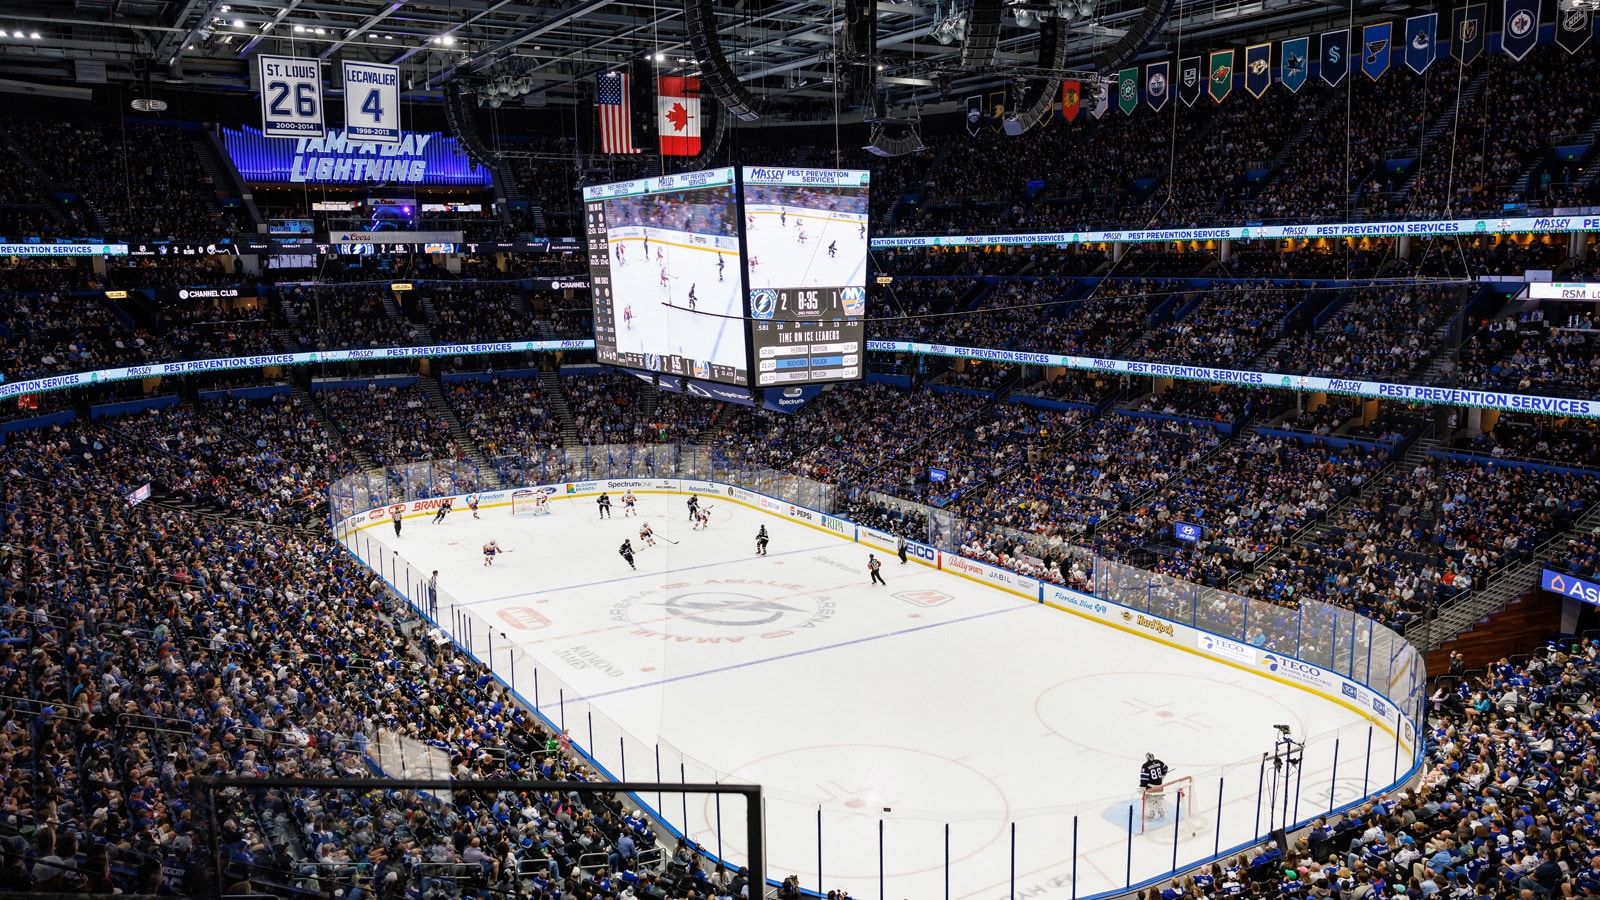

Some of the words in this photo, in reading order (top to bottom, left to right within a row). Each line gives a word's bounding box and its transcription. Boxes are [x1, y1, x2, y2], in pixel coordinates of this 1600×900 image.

[267, 64, 282, 76] ST.
[286, 66, 315, 78] LOUIS
[347, 70, 396, 86] LECAVALIER
[268, 80, 317, 118] 26
[360, 88, 384, 123] 4
[290, 156, 426, 182] LIGHTNING
[751, 168, 784, 180] MASSEY
[658, 176, 674, 186] MASSEY
[1282, 226, 1308, 235] MASSEY
[1317, 226, 1339, 234] PEST
[1341, 224, 1405, 234] PREVENTION
[1407, 223, 1459, 232] SERVICES
[1533, 218, 1570, 228] MASSEY
[1145, 230, 1191, 239] PREVENTION
[781, 293, 787, 310] 2
[798, 291, 818, 310] 8:35
[832, 292, 837, 308] 1
[779, 333, 792, 343] TIME
[795, 332, 802, 342] ON
[804, 332, 813, 341] ICE
[816, 330, 839, 340] LEADERS
[405, 346, 469, 356] PREVENTION
[471, 343, 512, 352] SERVICES
[930, 345, 947, 353] MASSEY
[954, 348, 970, 356] PEST
[971, 349, 1013, 360] PREVENTION
[1015, 353, 1049, 363] SERVICES
[127, 366, 152, 376] MASSEY
[164, 362, 185, 372] PEST
[187, 357, 248, 370] PREVENTION
[249, 354, 294, 365] SERVICES
[664, 357, 668, 371] 2
[687, 360, 690, 375] 1
[1093, 359, 1115, 368] MASSEY
[1127, 362, 1148, 372] PEST
[1150, 364, 1210, 378] PREVENTION
[1213, 370, 1262, 383] SERVICES
[42, 375, 80, 388] SERVICES
[1328, 379, 1362, 391] MASSEY
[1379, 384, 1412, 397] PEST
[1415, 387, 1508, 406] PREVENTION
[1511, 396, 1590, 414] SERVICES
[796, 509, 812, 520] PEPSI
[827, 517, 844, 533] RIPA
[906, 542, 934, 560] EICO
[949, 556, 968, 572] Bally
[968, 565, 983, 575] SPORTS
[988, 571, 1011, 584] JABIL
[1055, 592, 1078, 605] Florida
[1079, 599, 1093, 609] Blue
[1137, 615, 1155, 629] Hard
[1155, 620, 1174, 637] Rock
[1214, 639, 1244, 652] TECO
[1280, 658, 1320, 676] TECO
[1282, 667, 1300, 676] TAMPA
[1303, 674, 1332, 686] ELECTRIC
[1151, 768, 1162, 779] 88
